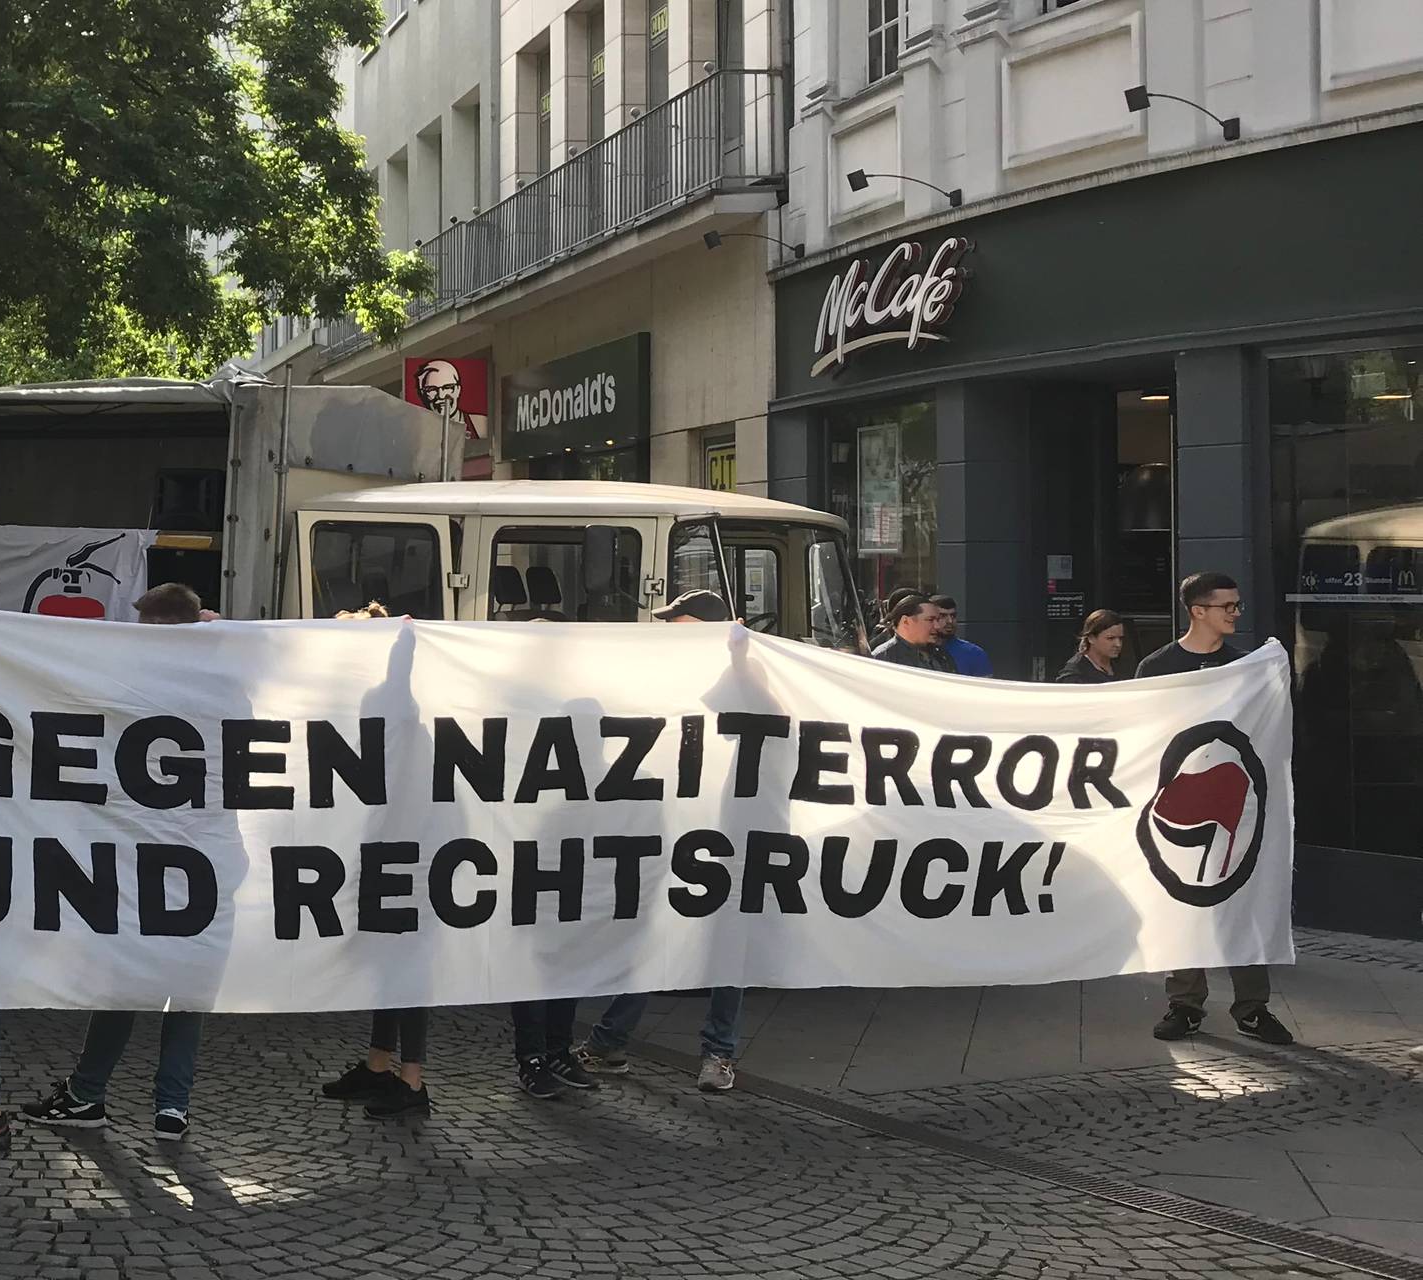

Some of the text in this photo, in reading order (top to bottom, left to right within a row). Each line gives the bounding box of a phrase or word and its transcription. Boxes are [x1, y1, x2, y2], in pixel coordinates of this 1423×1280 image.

[814, 237, 958, 364] McCafé
[516, 372, 616, 432] McDonald's
[1344, 572, 1363, 586] 23
[432, 712, 1132, 811] NAZITERROR
[271, 829, 1066, 940] RECHTSRUCK!
